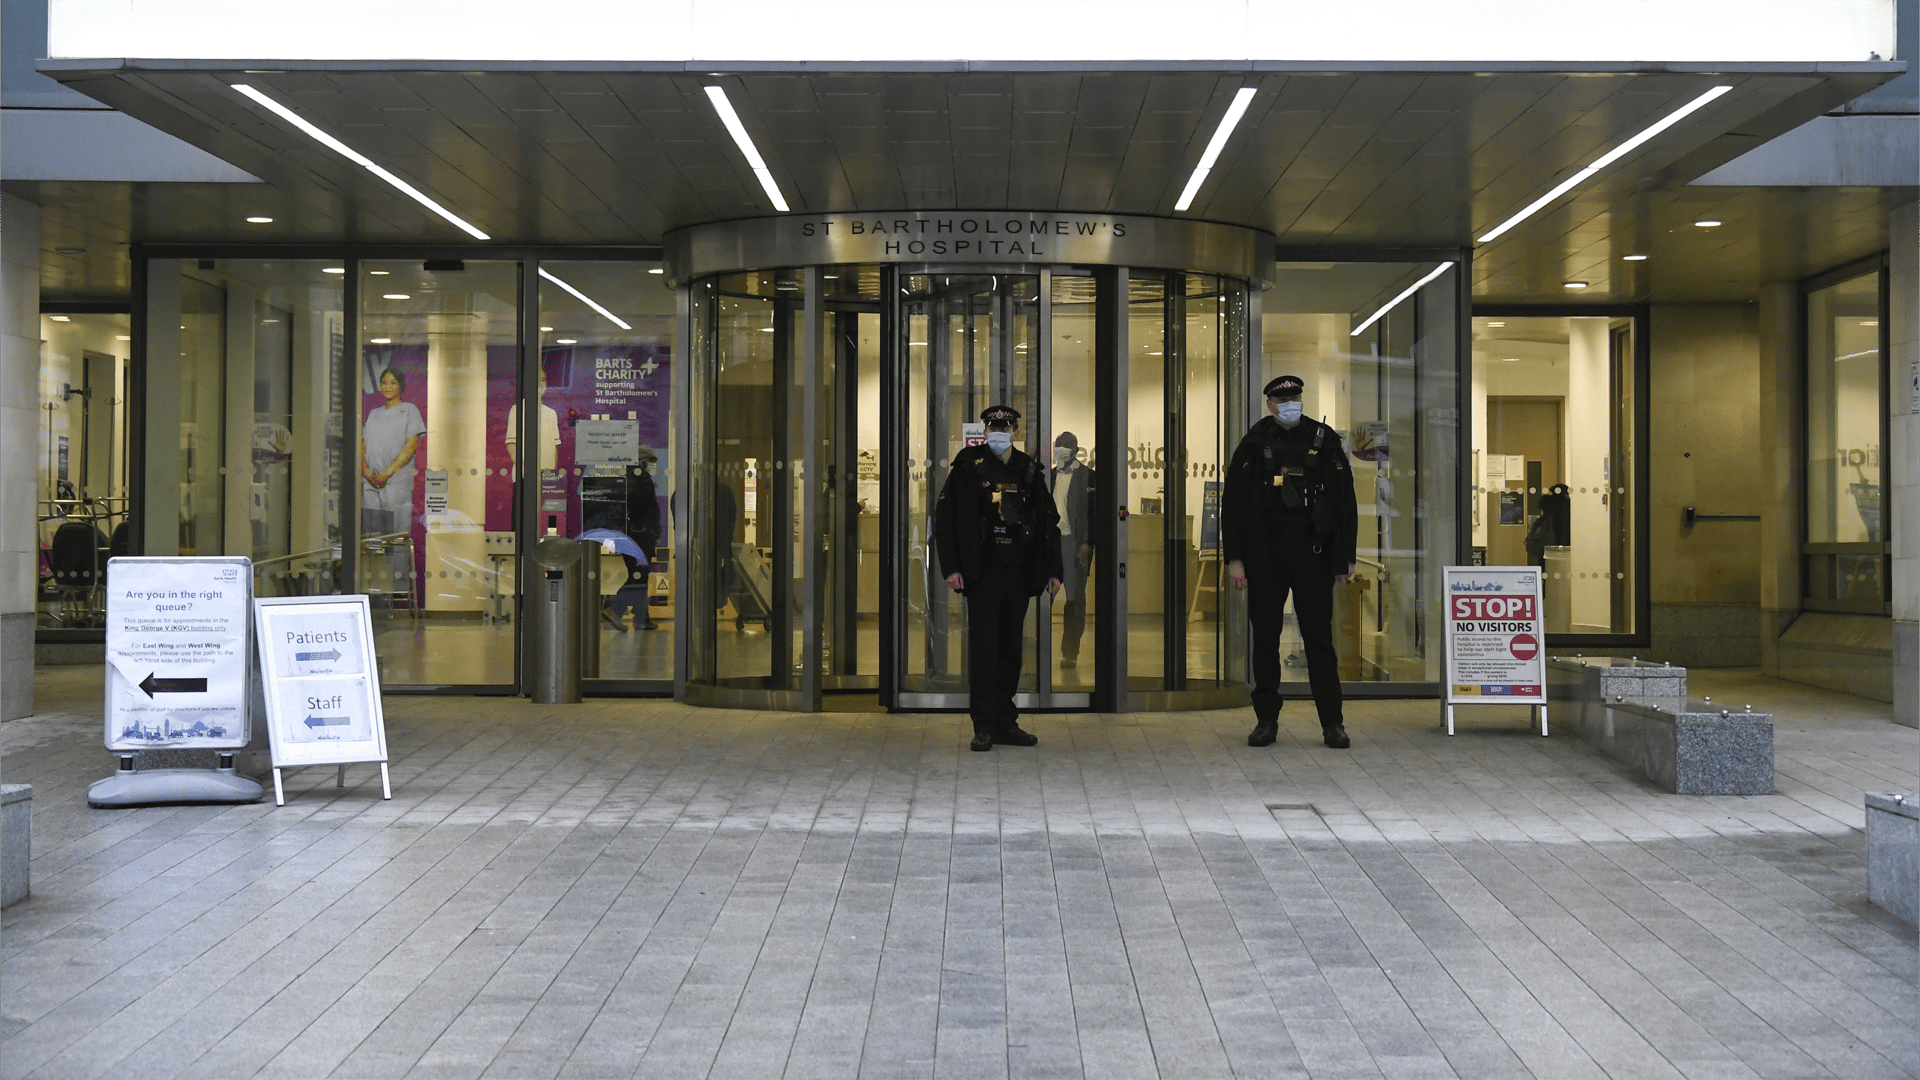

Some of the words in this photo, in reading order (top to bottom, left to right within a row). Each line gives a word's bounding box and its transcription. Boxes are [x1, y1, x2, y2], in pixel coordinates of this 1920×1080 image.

[802, 221, 834, 237] ST
[851, 219, 1126, 237] BARTHOLOMEW'S
[885, 240, 1043, 254] HOSPITAL
[596, 358, 632, 369] BARTS
[596, 369, 646, 380] CHARITY
[596, 381, 635, 389] supporting
[968, 438, 986, 447] ST
[126, 590, 144, 599] Are
[147, 592, 166, 601] you
[168, 590, 178, 599] in
[180, 590, 196, 599] the
[199, 590, 223, 601] right
[155, 602, 193, 612] queue?
[1456, 598, 1532, 618] STOP!
[1456, 622, 1475, 632] NO
[1478, 622, 1532, 632] VISITORS
[286, 630, 347, 644] Patients
[307, 696, 342, 710] Staff
